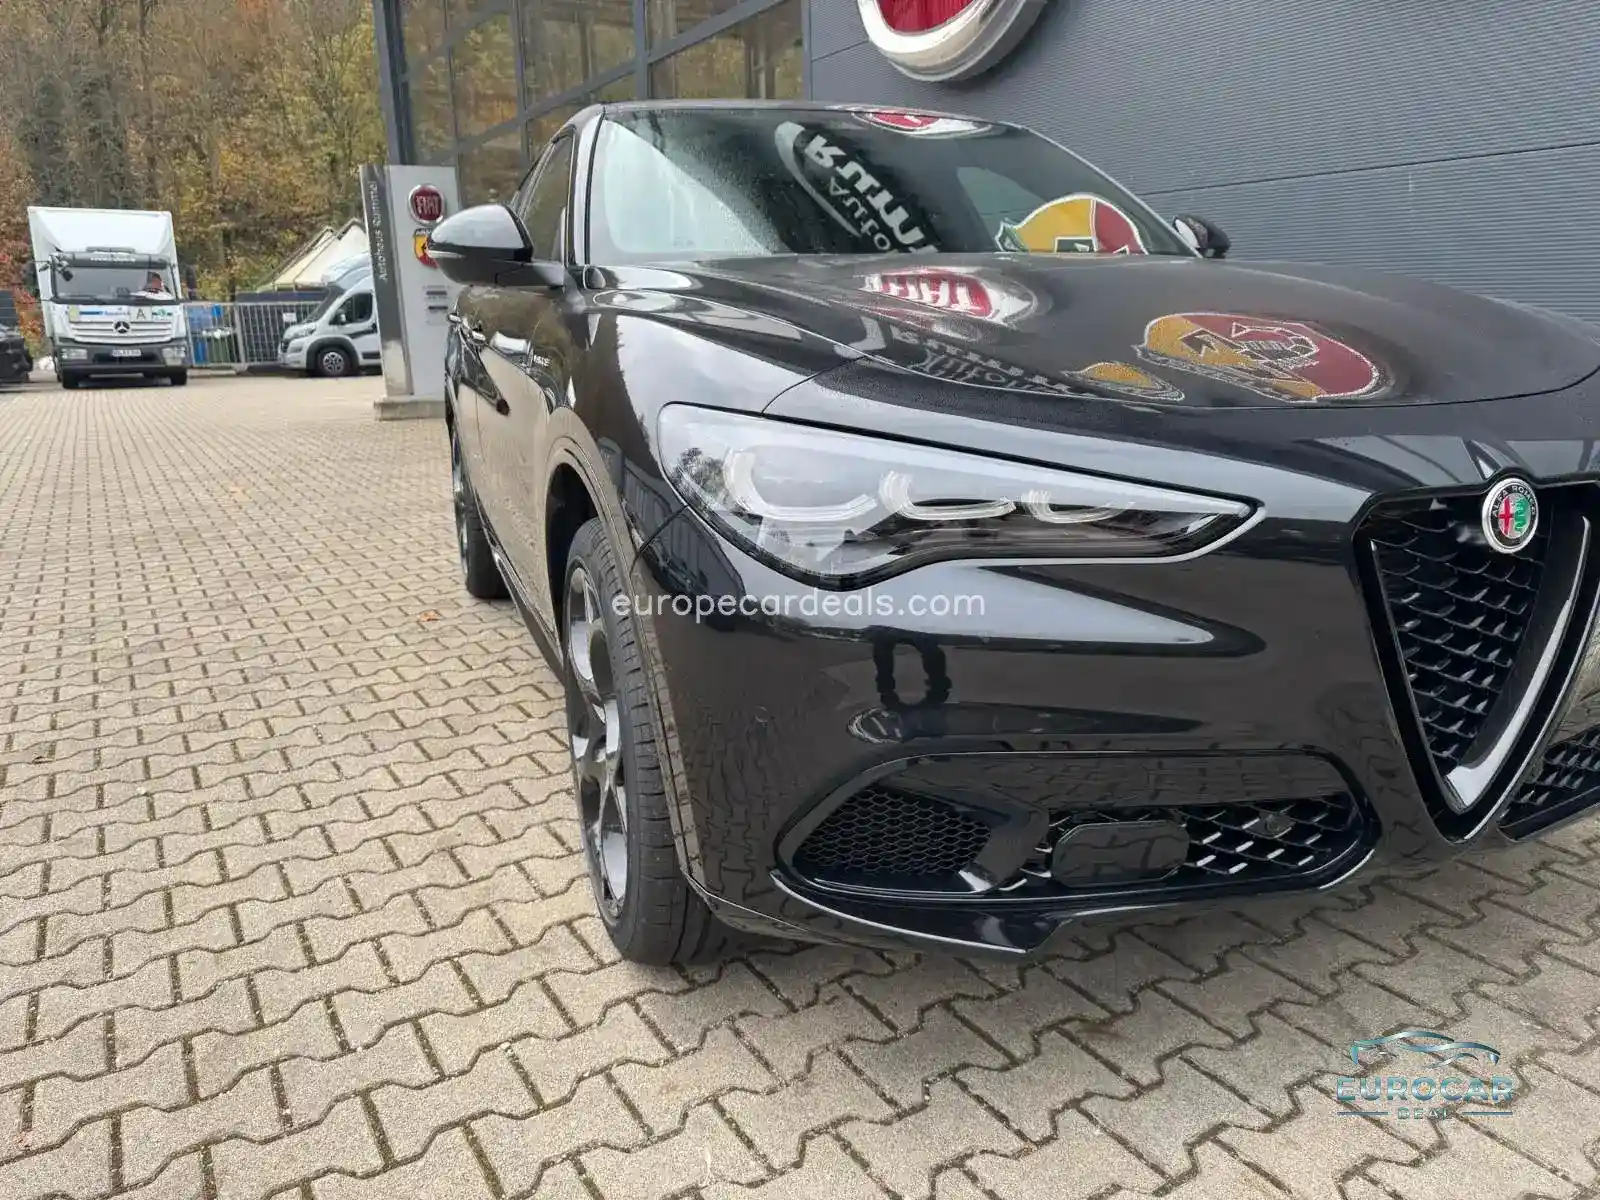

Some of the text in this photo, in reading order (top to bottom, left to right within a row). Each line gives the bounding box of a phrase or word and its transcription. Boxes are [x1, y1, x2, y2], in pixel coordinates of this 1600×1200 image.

[415, 195, 440, 216] FIAT
[1492, 485, 1537, 518] ALFA ROMEO
